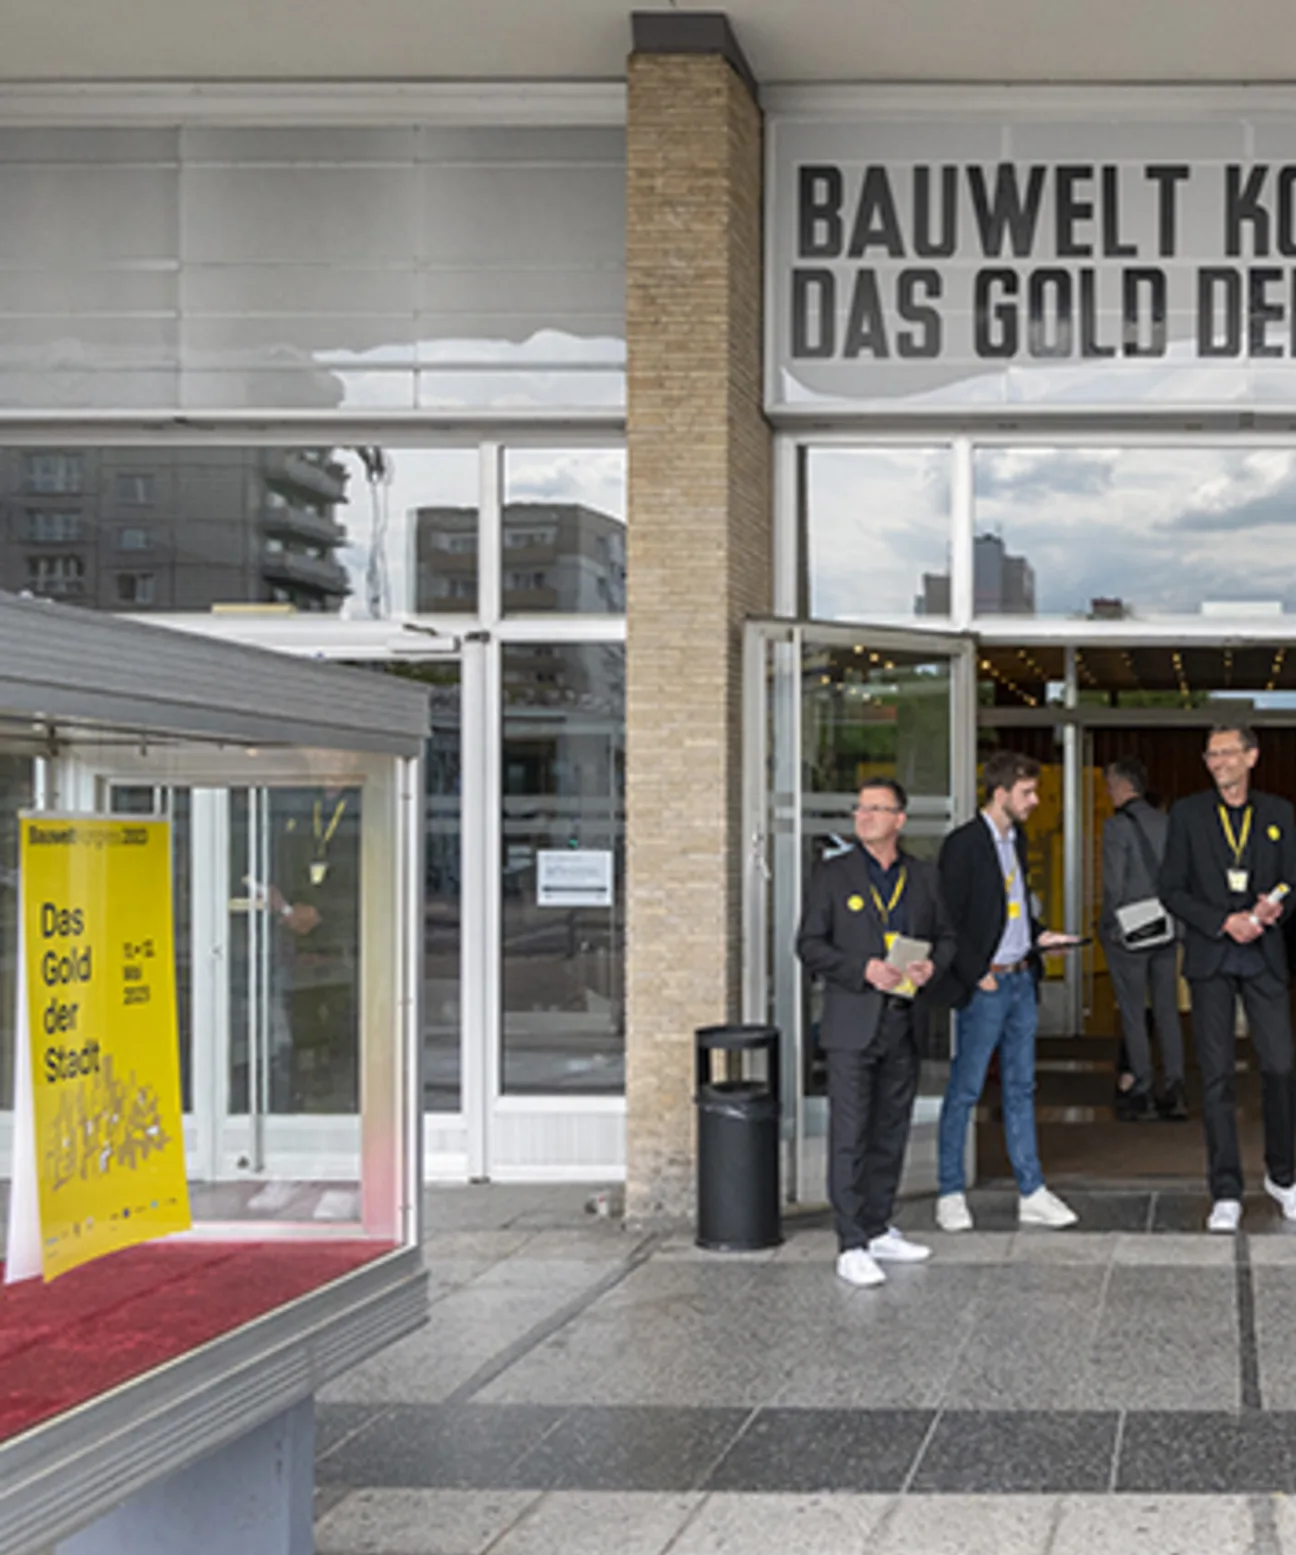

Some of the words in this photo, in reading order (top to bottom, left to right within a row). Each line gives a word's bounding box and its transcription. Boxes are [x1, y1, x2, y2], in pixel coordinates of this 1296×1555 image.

[797, 163, 1190, 259] BAUWELT
[791, 267, 942, 359] DAS
[974, 267, 1167, 359] GOLD
[42, 902, 84, 938] Das
[42, 945, 92, 986] Gold
[44, 997, 78, 1034] der
[45, 1039, 100, 1083] Stadt
